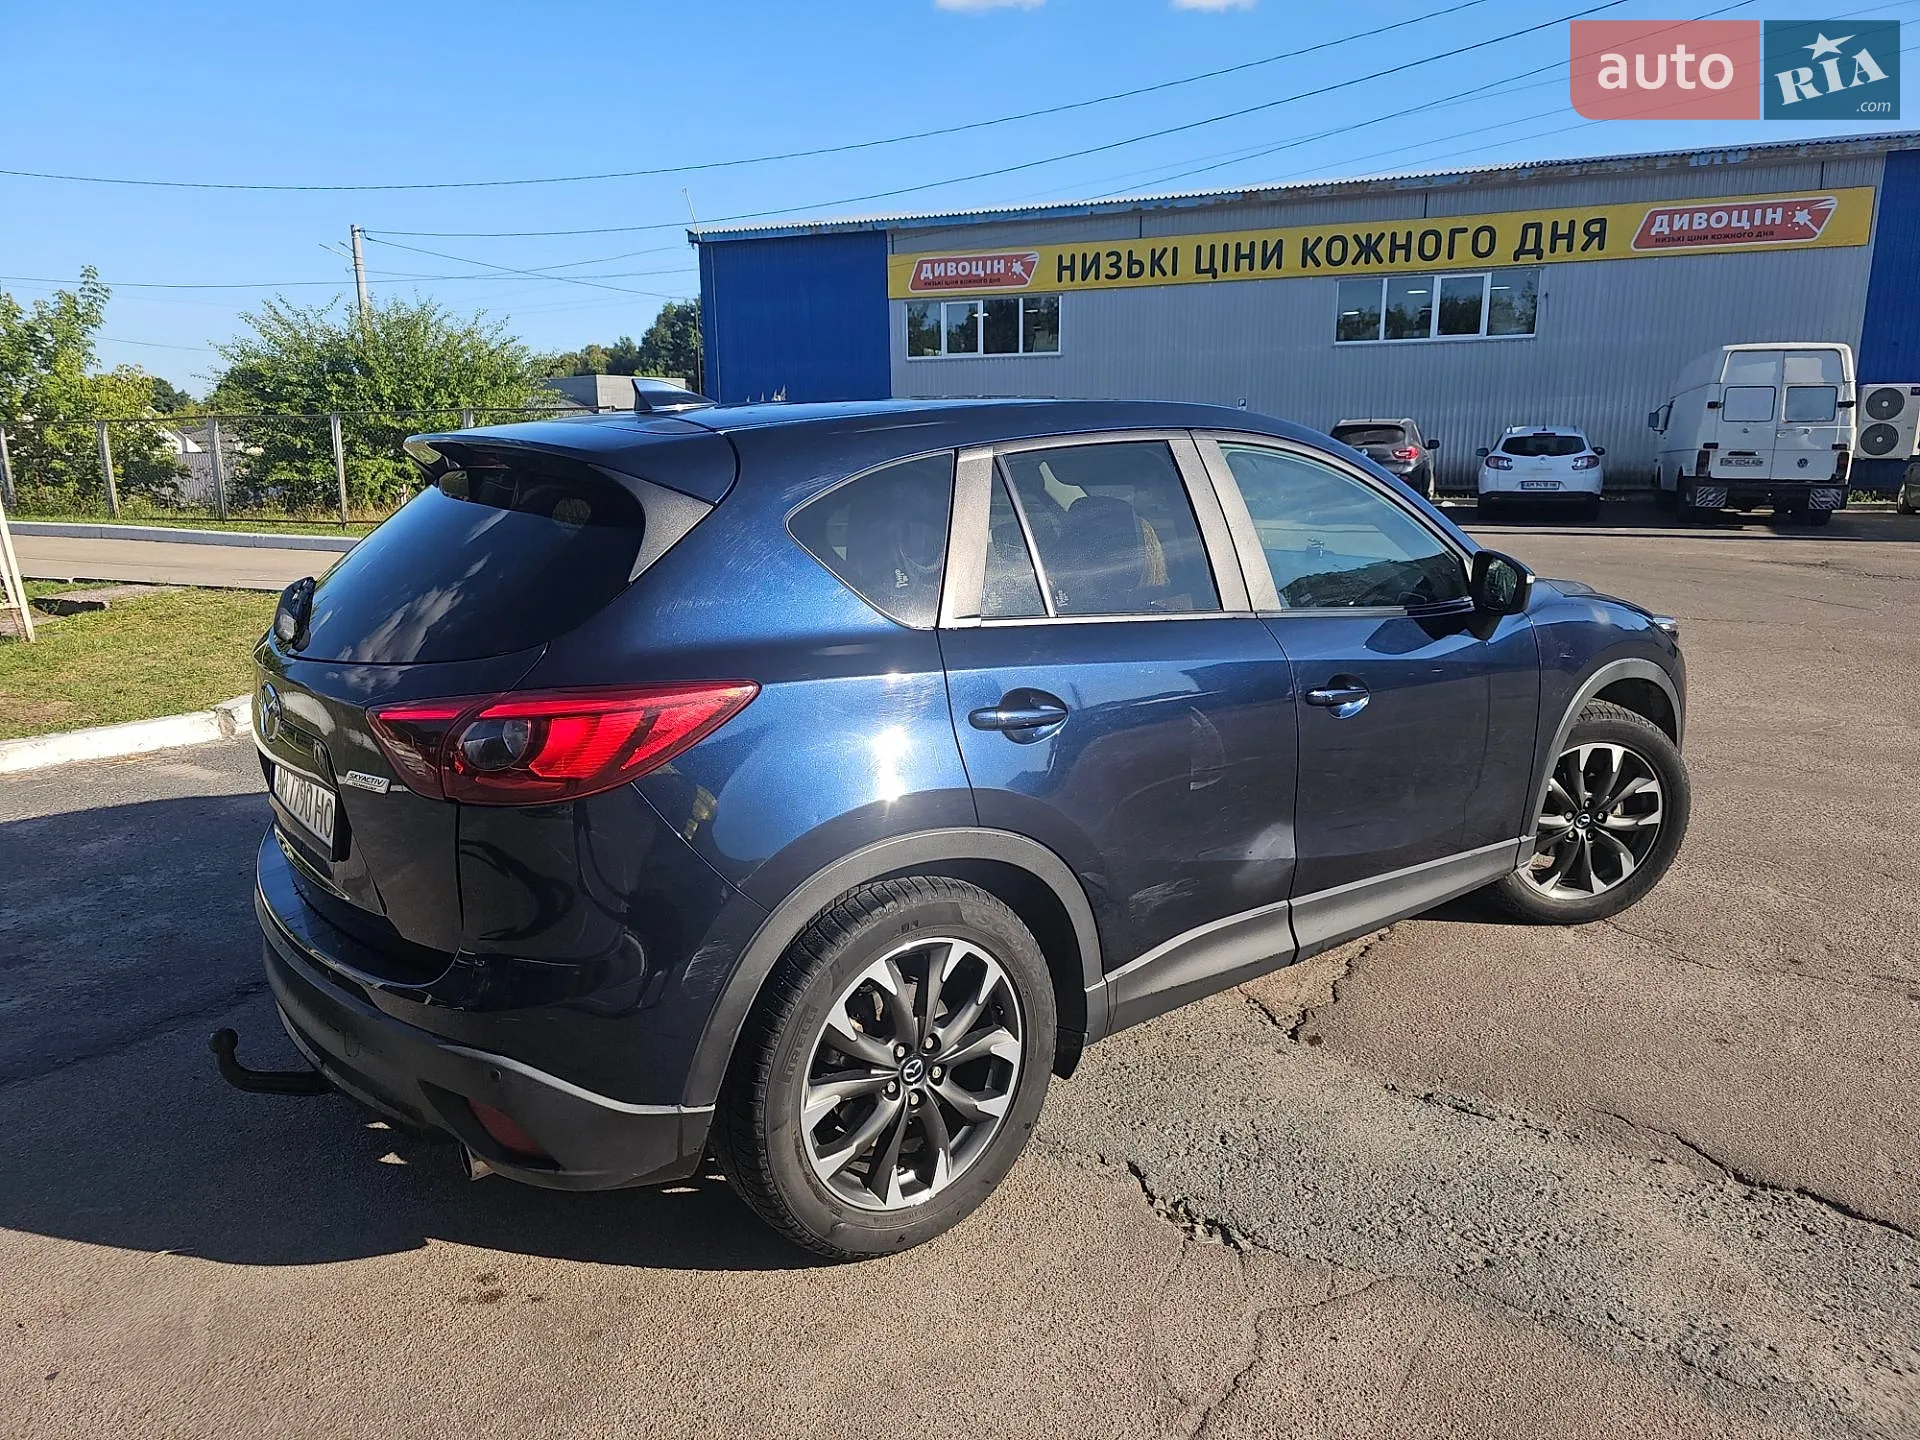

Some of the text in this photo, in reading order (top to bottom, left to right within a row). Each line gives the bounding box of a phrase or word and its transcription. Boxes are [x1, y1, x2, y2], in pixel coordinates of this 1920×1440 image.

[1650, 207, 1784, 236] ДИВОЦІН
[1711, 230, 1754, 241] КОЖНОГО
[1056, 217, 1608, 284] НИЗЬКІ ЦІНИ КОЖНОГО ДНЯ
[920, 258, 1006, 281] ДИВОЦІН
[349, 772, 384, 786] SKYACTIV
